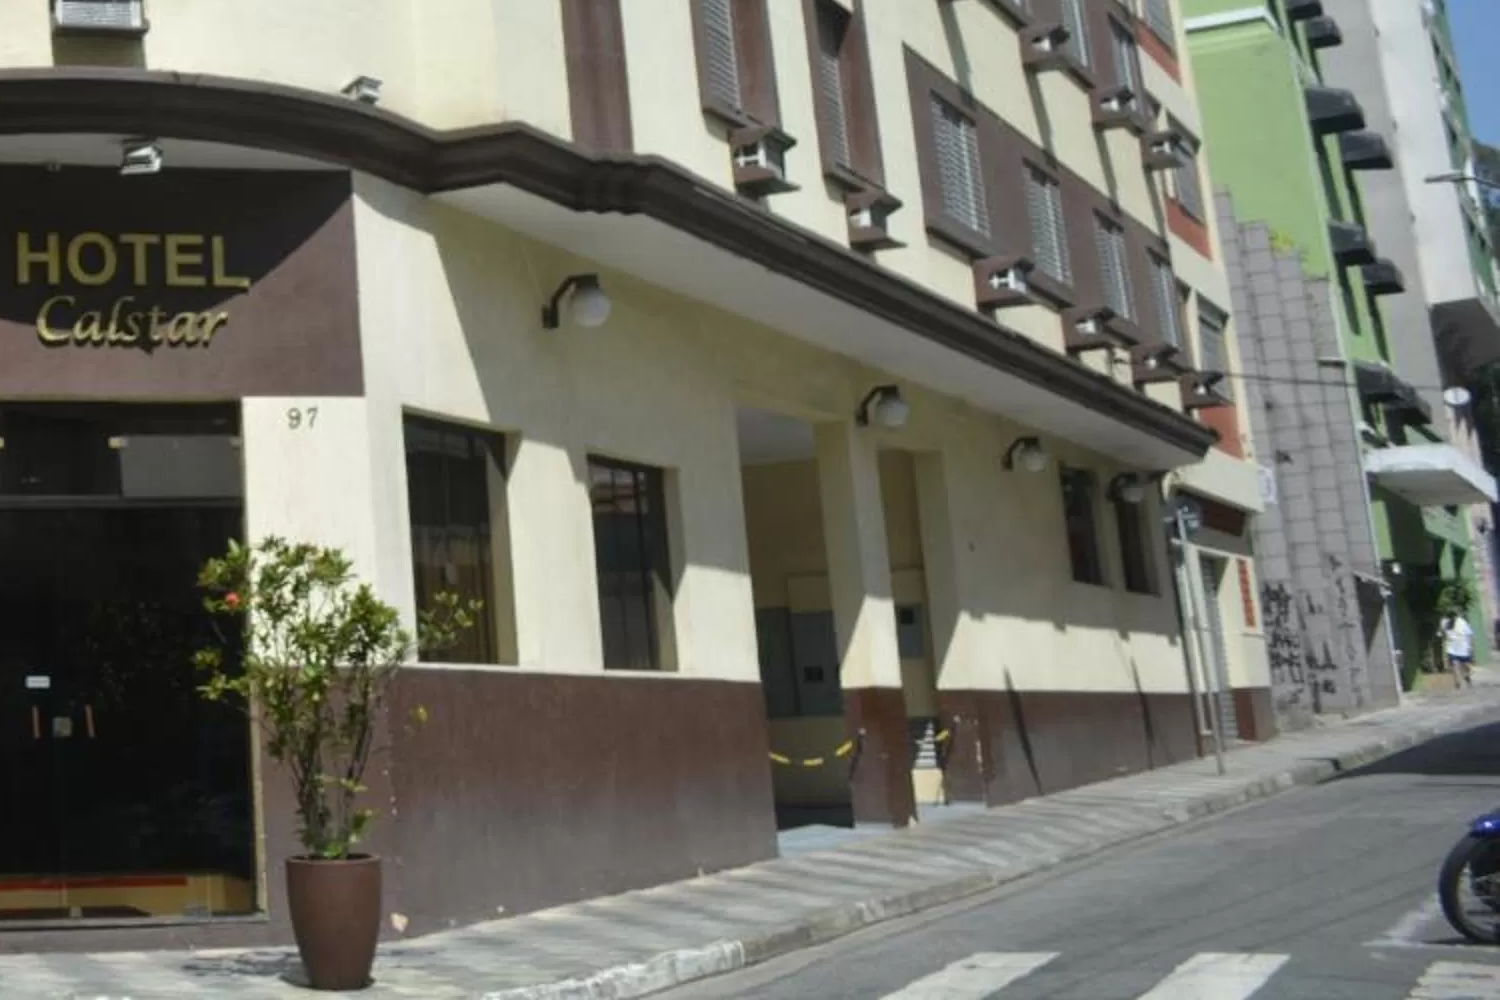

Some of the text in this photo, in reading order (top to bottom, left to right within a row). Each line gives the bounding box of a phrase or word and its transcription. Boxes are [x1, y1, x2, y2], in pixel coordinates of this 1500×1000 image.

[16, 231, 251, 288] HOTEL
[36, 295, 230, 344] Calstar
[287, 407, 318, 429] 97
